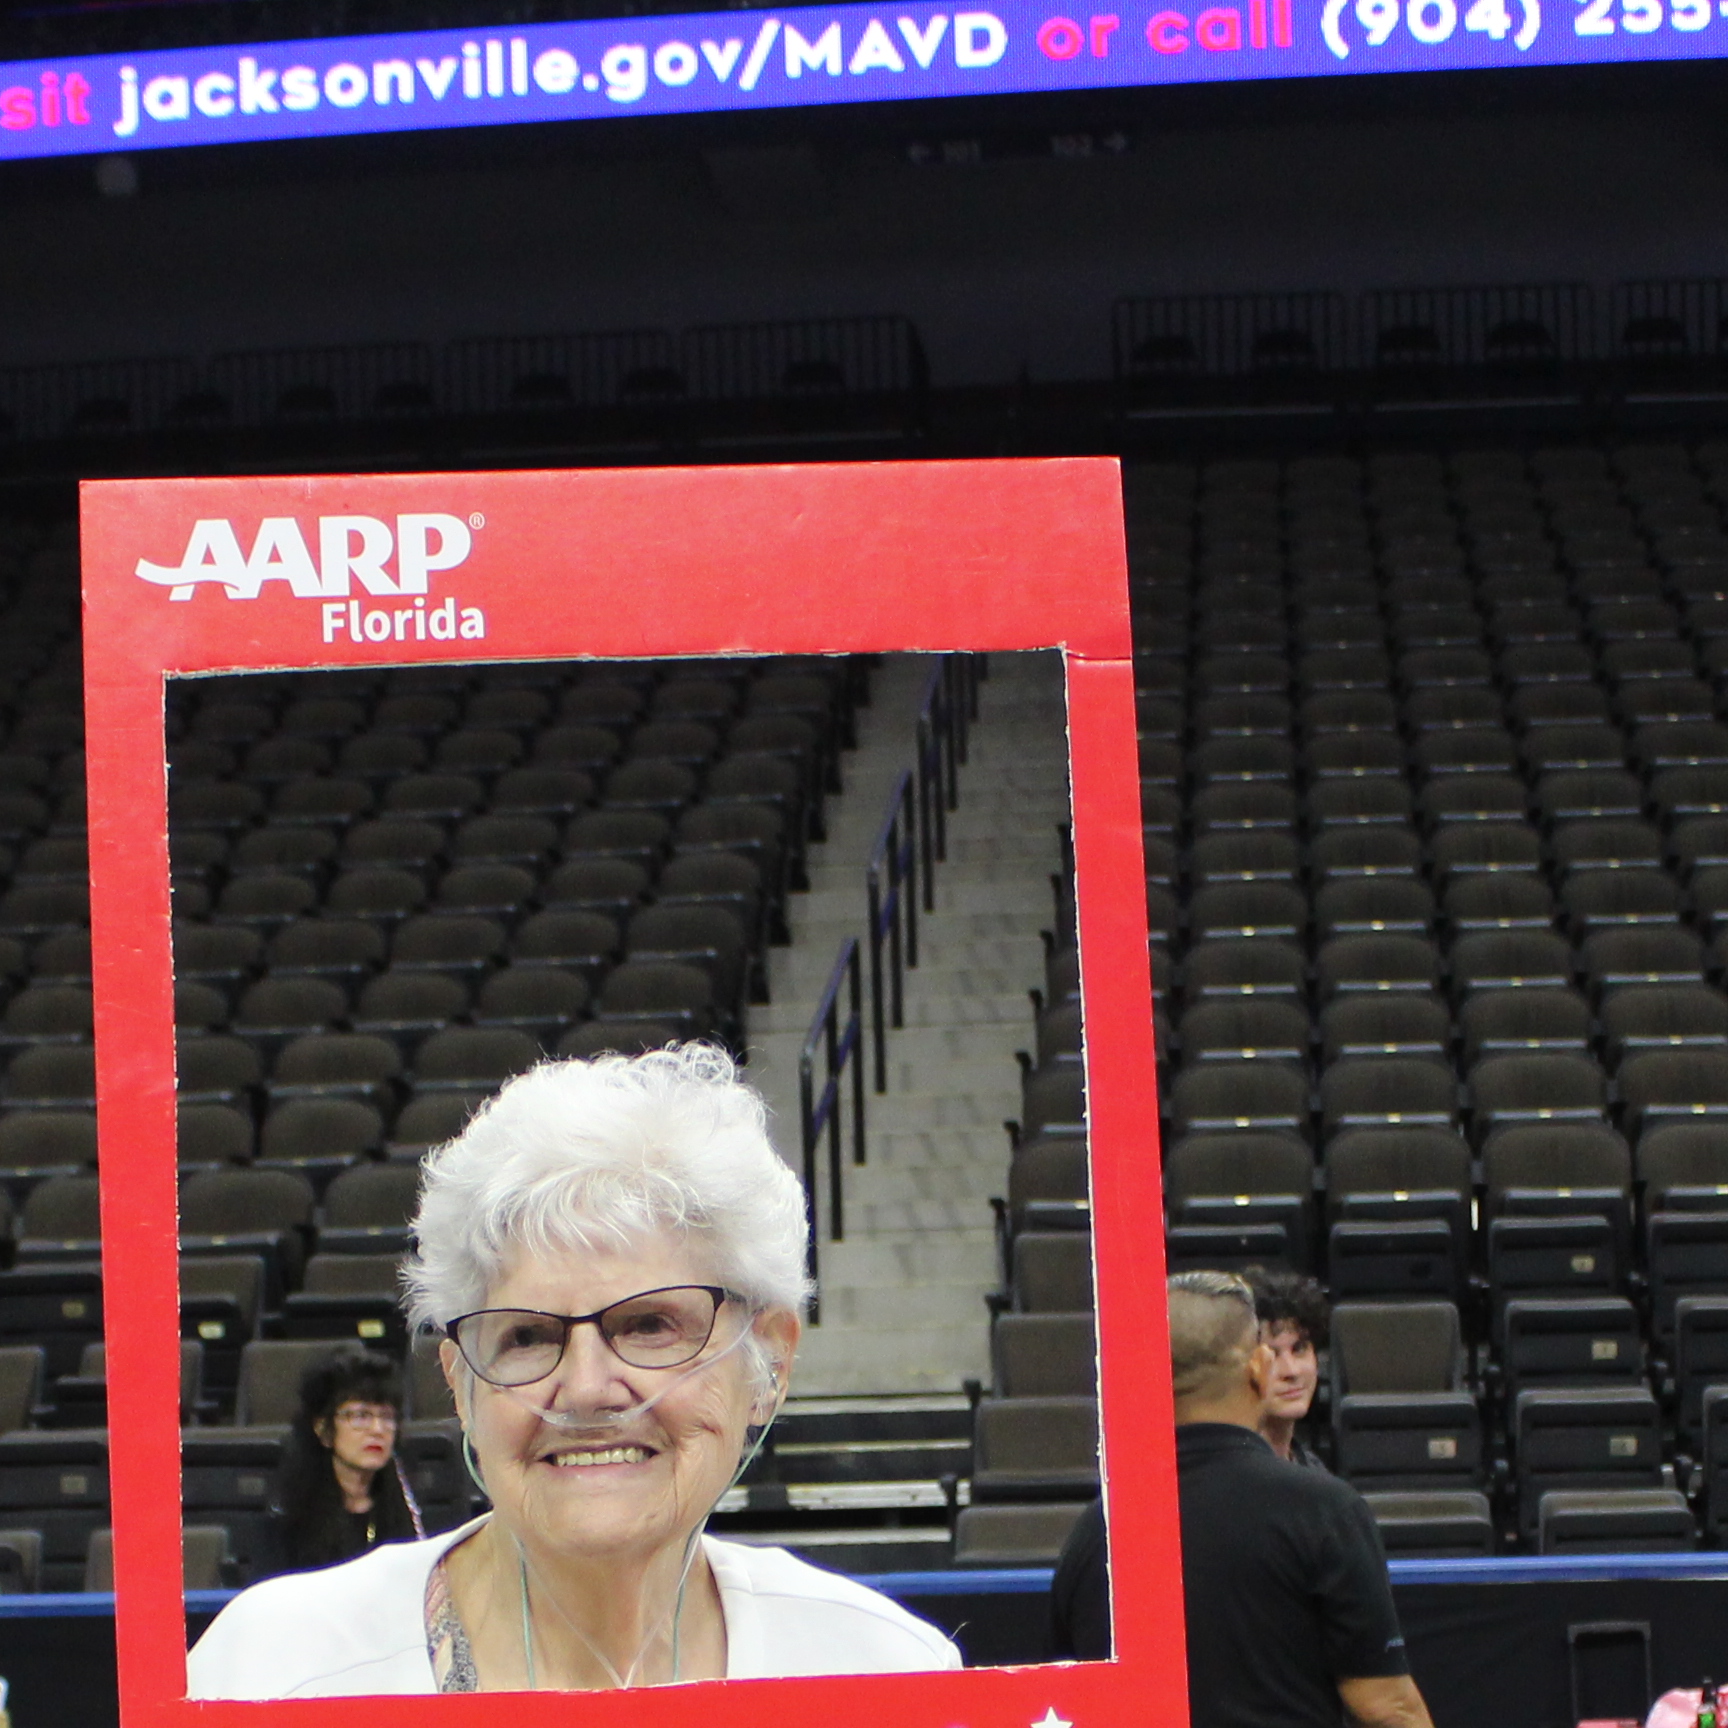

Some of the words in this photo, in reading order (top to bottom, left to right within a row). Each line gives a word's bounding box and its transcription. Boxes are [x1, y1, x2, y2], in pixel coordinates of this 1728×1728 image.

[112, 12, 1009, 138] jacksonville.gov/MAVD
[1036, 14, 1121, 61] or
[1145, 0, 1294, 54] call
[1320, 0, 1542, 60] (904)
[320, 597, 486, 643] Florida
